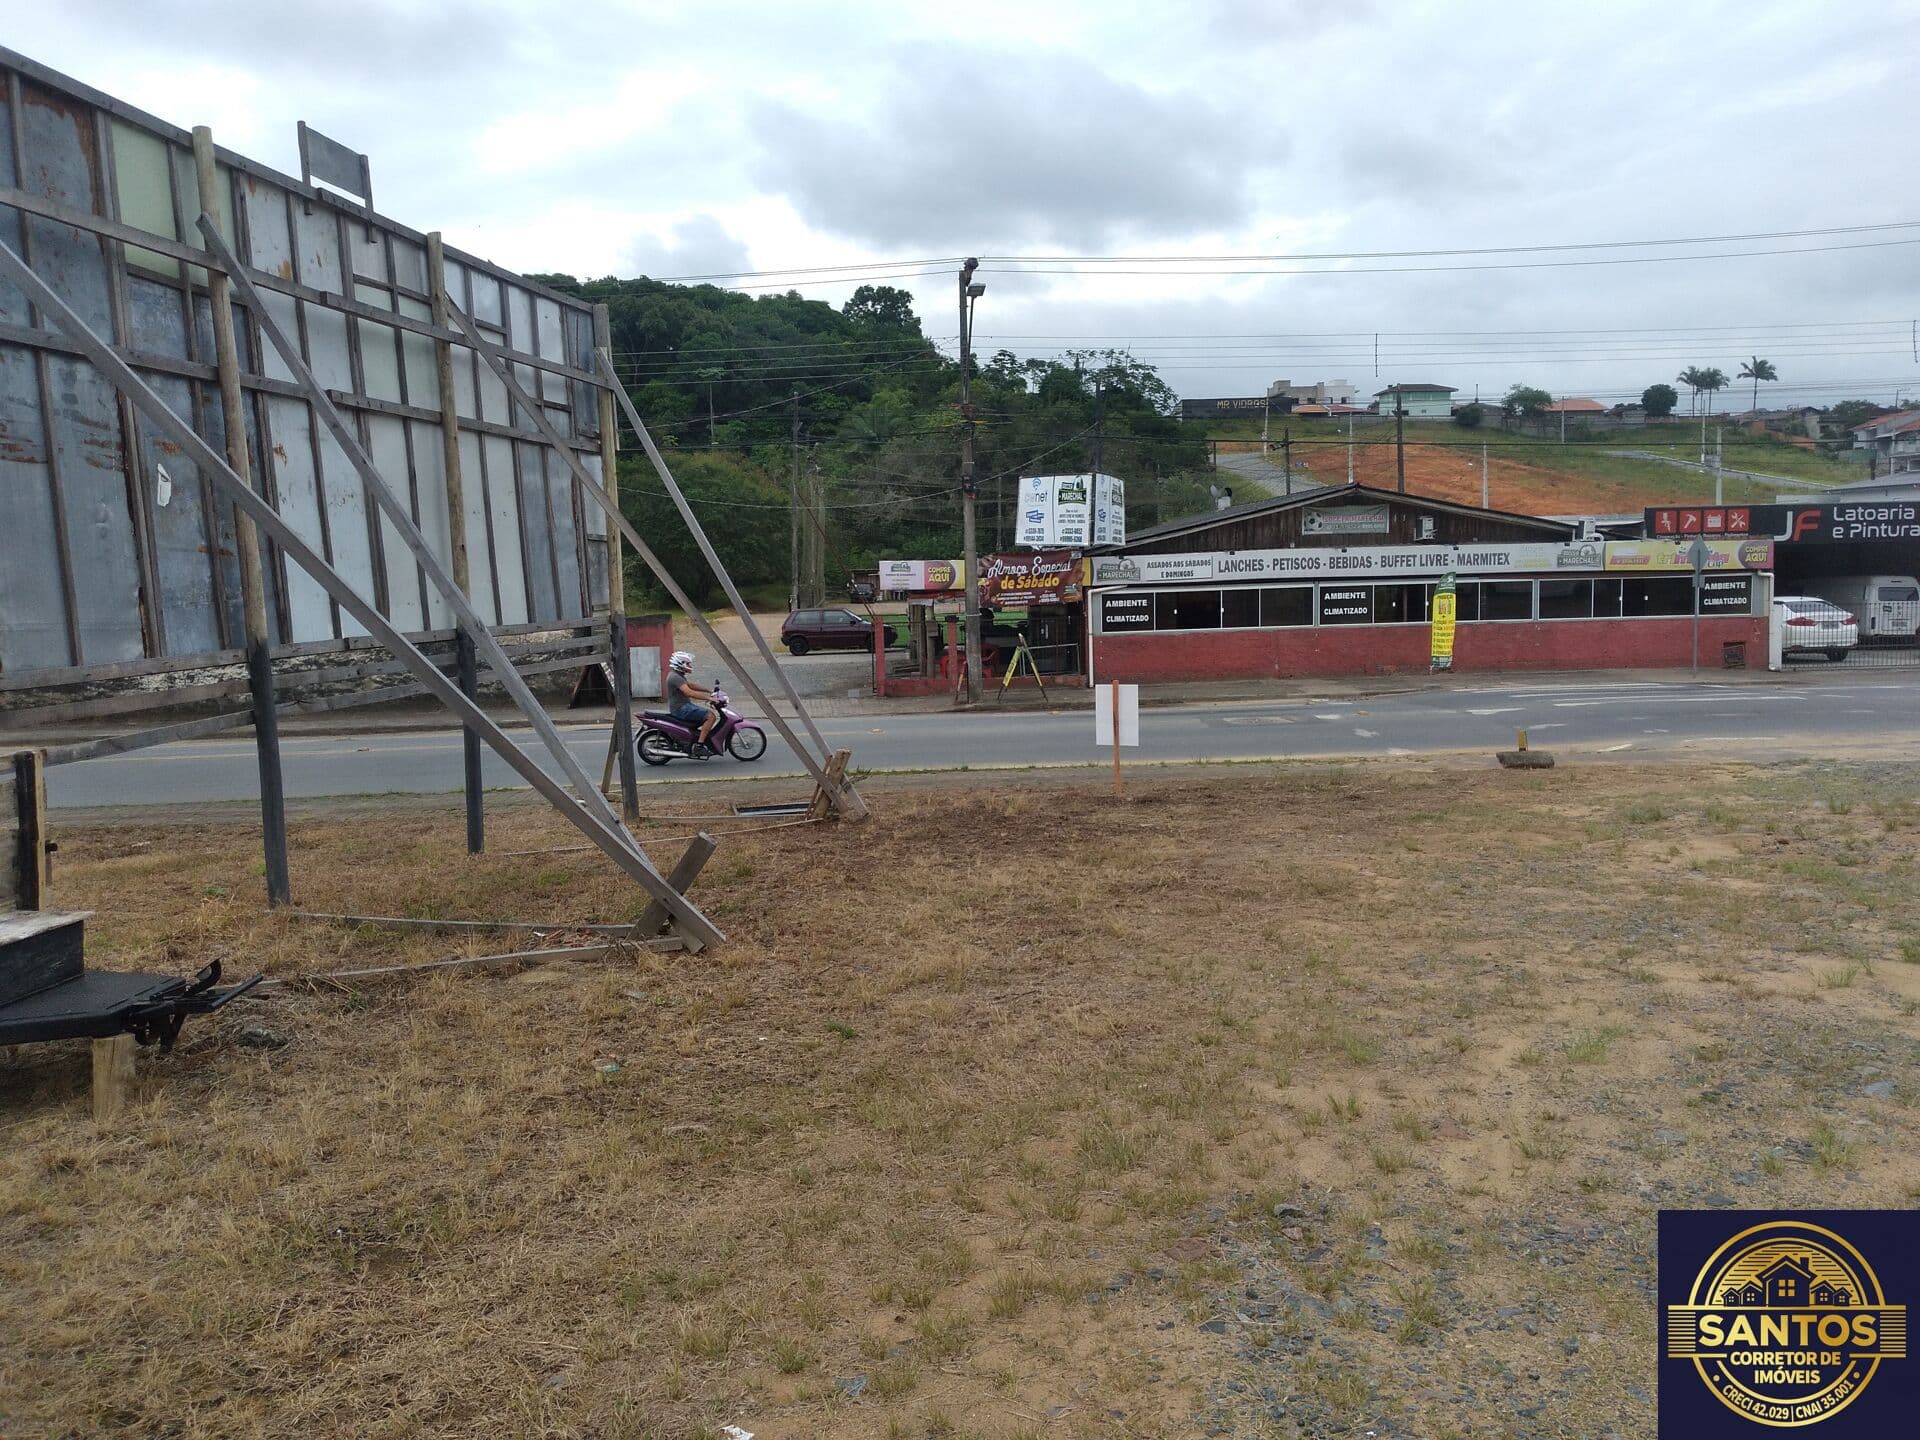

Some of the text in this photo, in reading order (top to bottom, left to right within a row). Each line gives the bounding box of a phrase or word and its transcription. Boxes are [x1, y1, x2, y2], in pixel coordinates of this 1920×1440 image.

[1061, 491, 1083, 501] MARECHAL
[1833, 504, 1915, 521] Latoaria
[1832, 522, 1920, 538] e Pintura
[1745, 545, 1769, 553] COMPRE
[1745, 552, 1767, 562] AQUI
[987, 556, 1073, 578] Almoço Especial
[1146, 561, 1173, 569] ASSADOS
[1218, 558, 1265, 573] LANCHES
[1272, 556, 1321, 571] PETISCOS
[1329, 555, 1373, 570] BEBIDAS
[1380, 554, 1418, 568] BUFFET
[1420, 553, 1449, 567] LIVRE
[1457, 552, 1511, 566] MARMITEX
[927, 566, 951, 574] COMPRE
[1165, 570, 1194, 578] DOMINGOS
[928, 573, 950, 583] AQUI
[1102, 571, 1134, 579] MARECHAL
[1000, 574, 1060, 590] de Sábado
[1705, 581, 1746, 590] AMBIENTE
[1324, 591, 1367, 600] AMBIENTE
[1105, 599, 1148, 608] AMBIENTE
[1703, 597, 1748, 606] CLIMATIZADO
[1324, 607, 1369, 616] CLIMATIZADO
[1105, 615, 1150, 623] CLIMATIZADO
